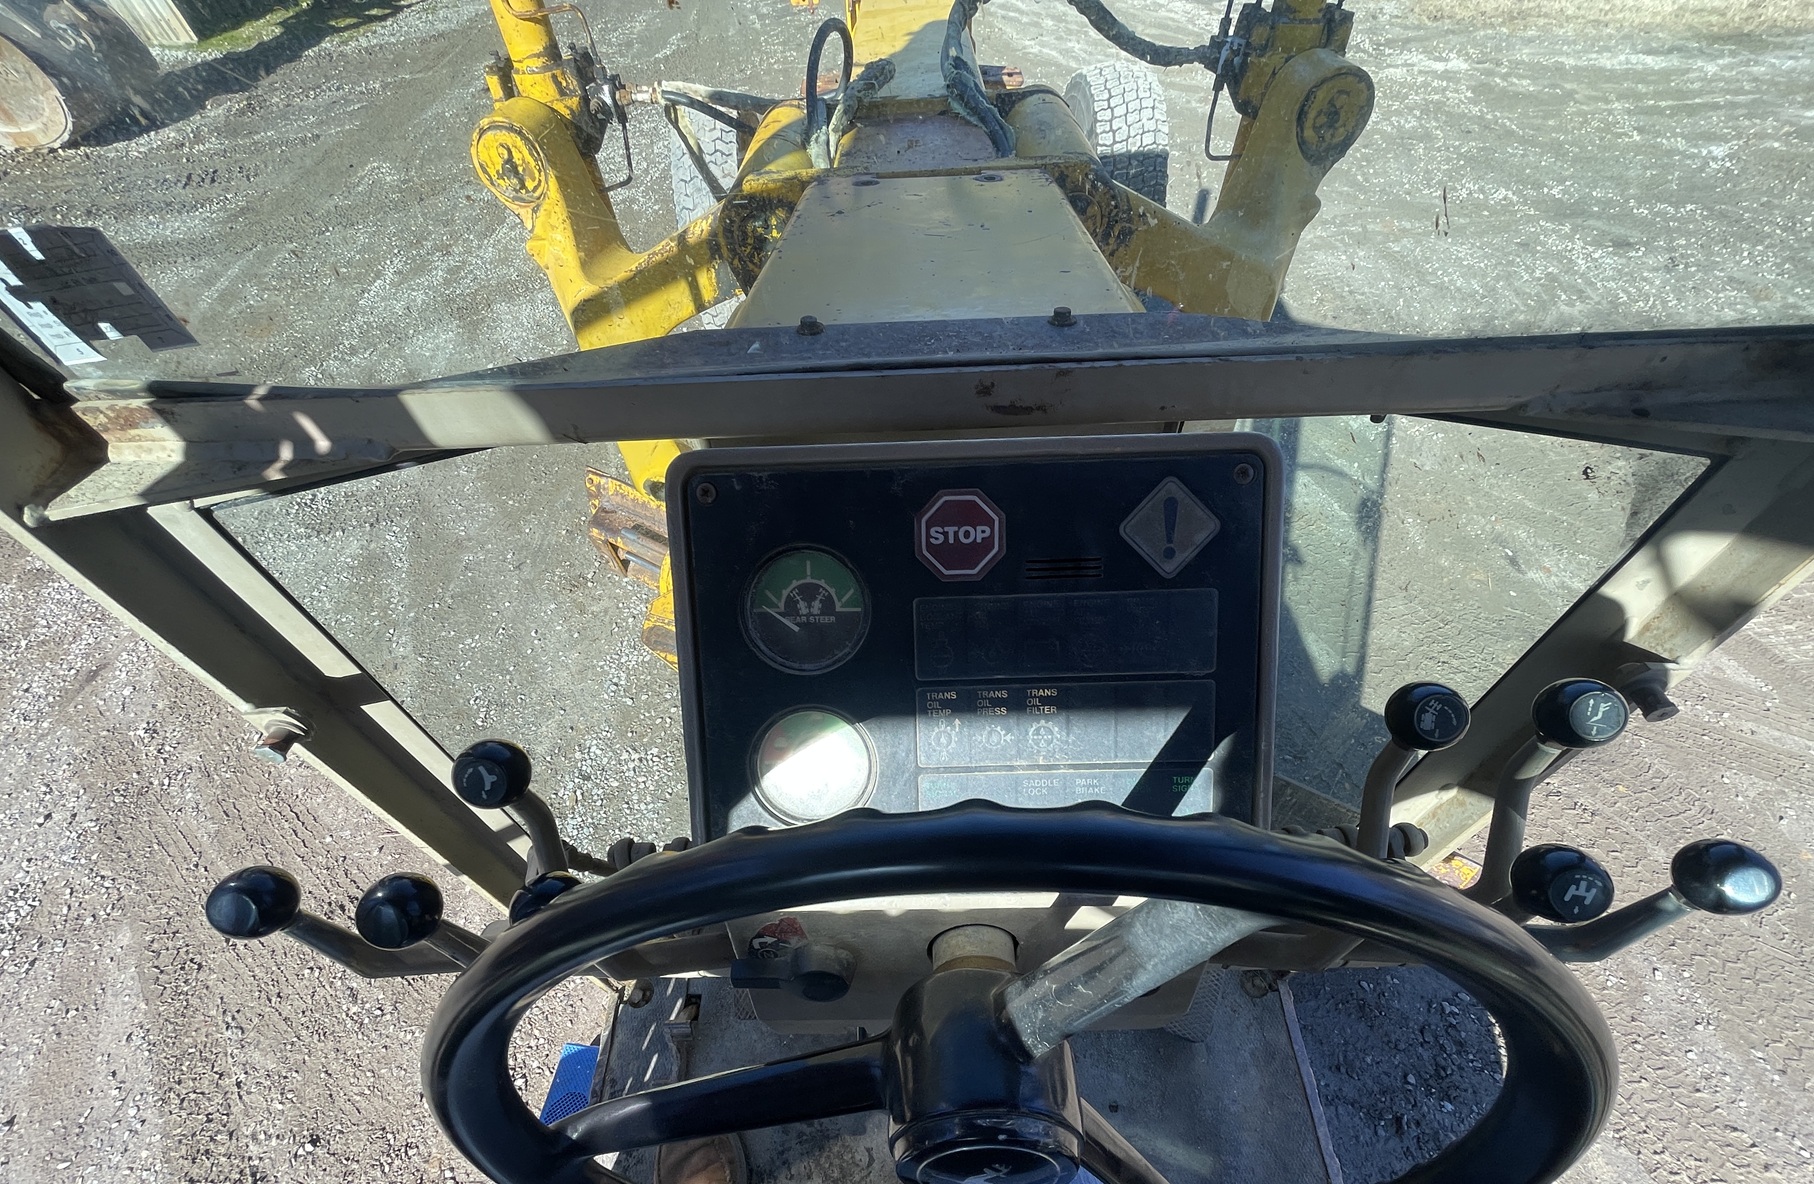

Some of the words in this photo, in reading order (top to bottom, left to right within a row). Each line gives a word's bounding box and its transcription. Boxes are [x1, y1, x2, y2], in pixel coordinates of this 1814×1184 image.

[929, 526, 991, 545] STOP
[809, 615, 836, 623] STEER
[926, 691, 957, 700] TRANS
[977, 690, 1008, 698] TRANS
[1026, 688, 1058, 697] TRANS
[926, 701, 942, 709] OIL
[977, 699, 992, 707] OIL
[1026, 698, 1042, 706] OIL
[926, 709, 952, 717] TEMP
[977, 707, 1007, 715] PRESS
[1026, 706, 1058, 715] FILTER
[1022, 778, 1060, 787] SADDLE
[1075, 778, 1100, 786] PARK
[1023, 787, 1048, 796] LOCK
[1075, 786, 1106, 795] BRAKE
